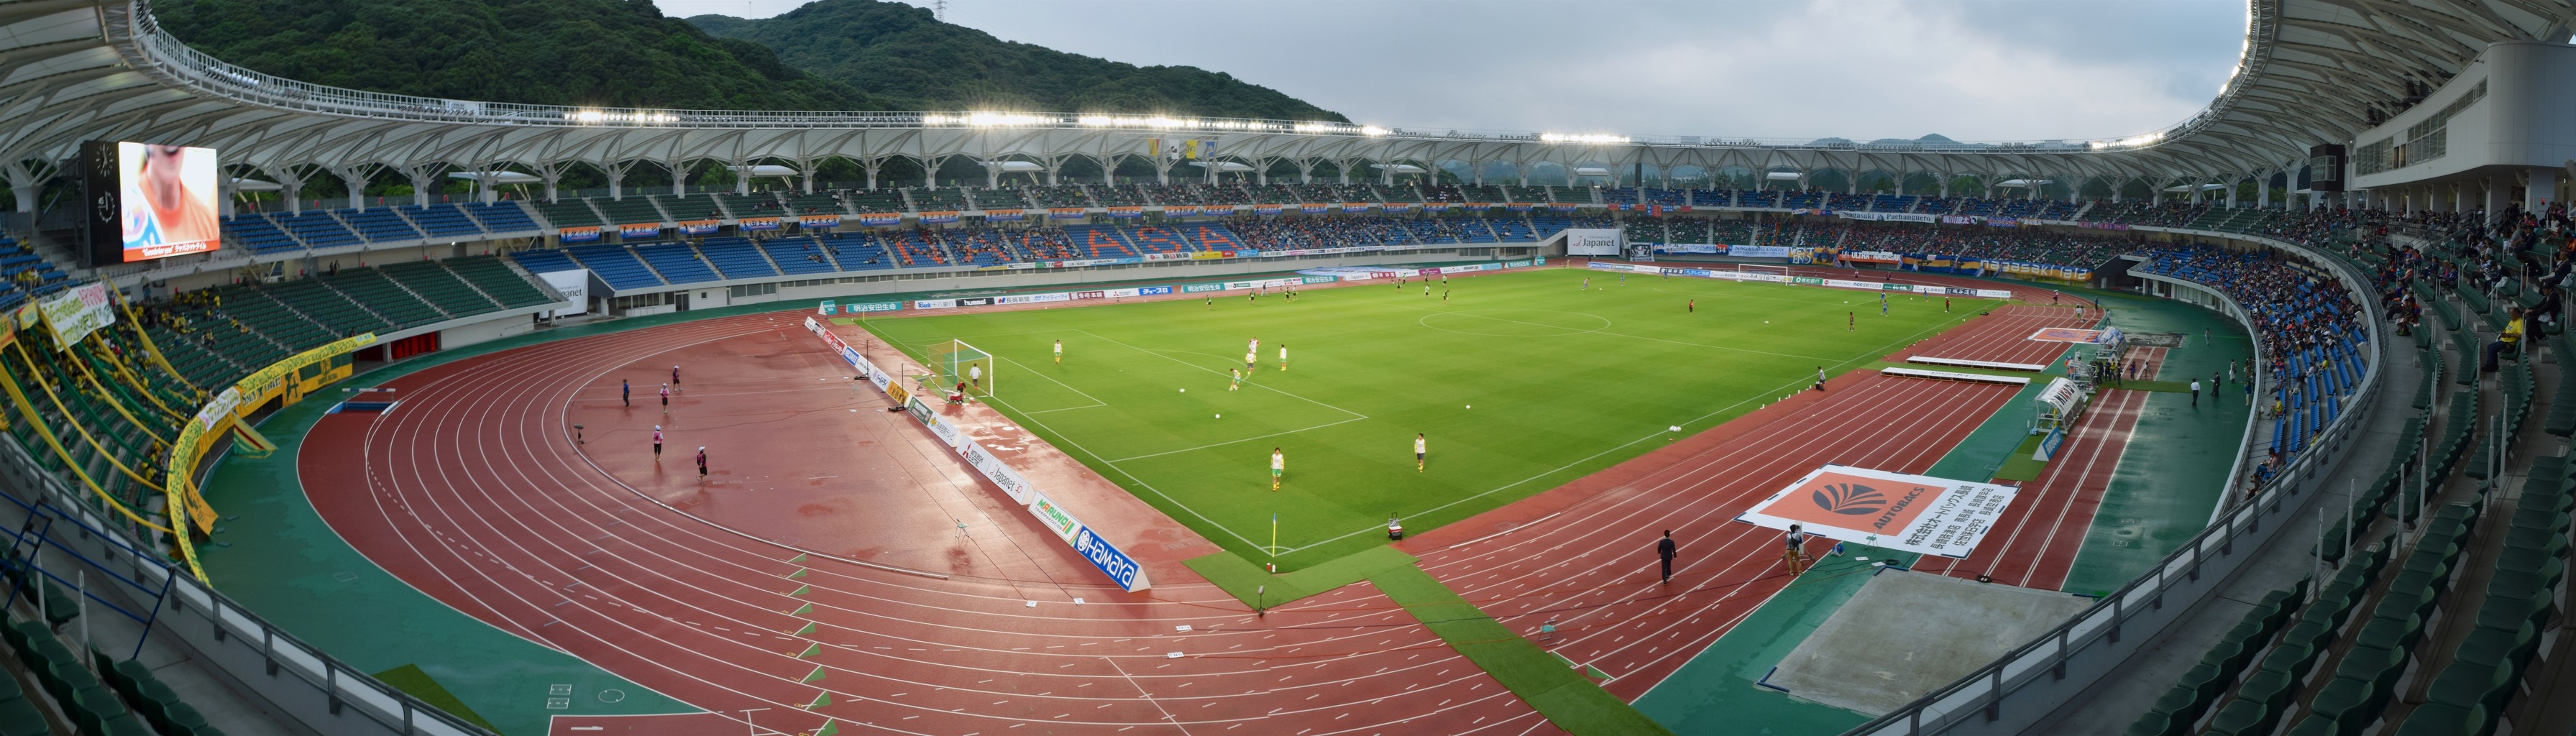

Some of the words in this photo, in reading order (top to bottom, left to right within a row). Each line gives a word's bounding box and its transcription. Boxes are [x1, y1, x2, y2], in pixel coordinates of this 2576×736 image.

[1843, 211, 1874, 220] Nagasaki
[1582, 238, 1615, 248] Japanet
[1789, 247, 1813, 256] WEST
[1980, 259, 2055, 276] nagasaki
[853, 303, 897, 312] 明治安田生命
[968, 455, 979, 467] ELECTRIC
[971, 449, 984, 463] MITSUBISHI
[994, 467, 1016, 492] Japanet
[1037, 499, 1069, 526] MARUNO
[1873, 486, 1926, 530] AUTOBACS
[1035, 507, 1063, 530] TRANSPORTATION
